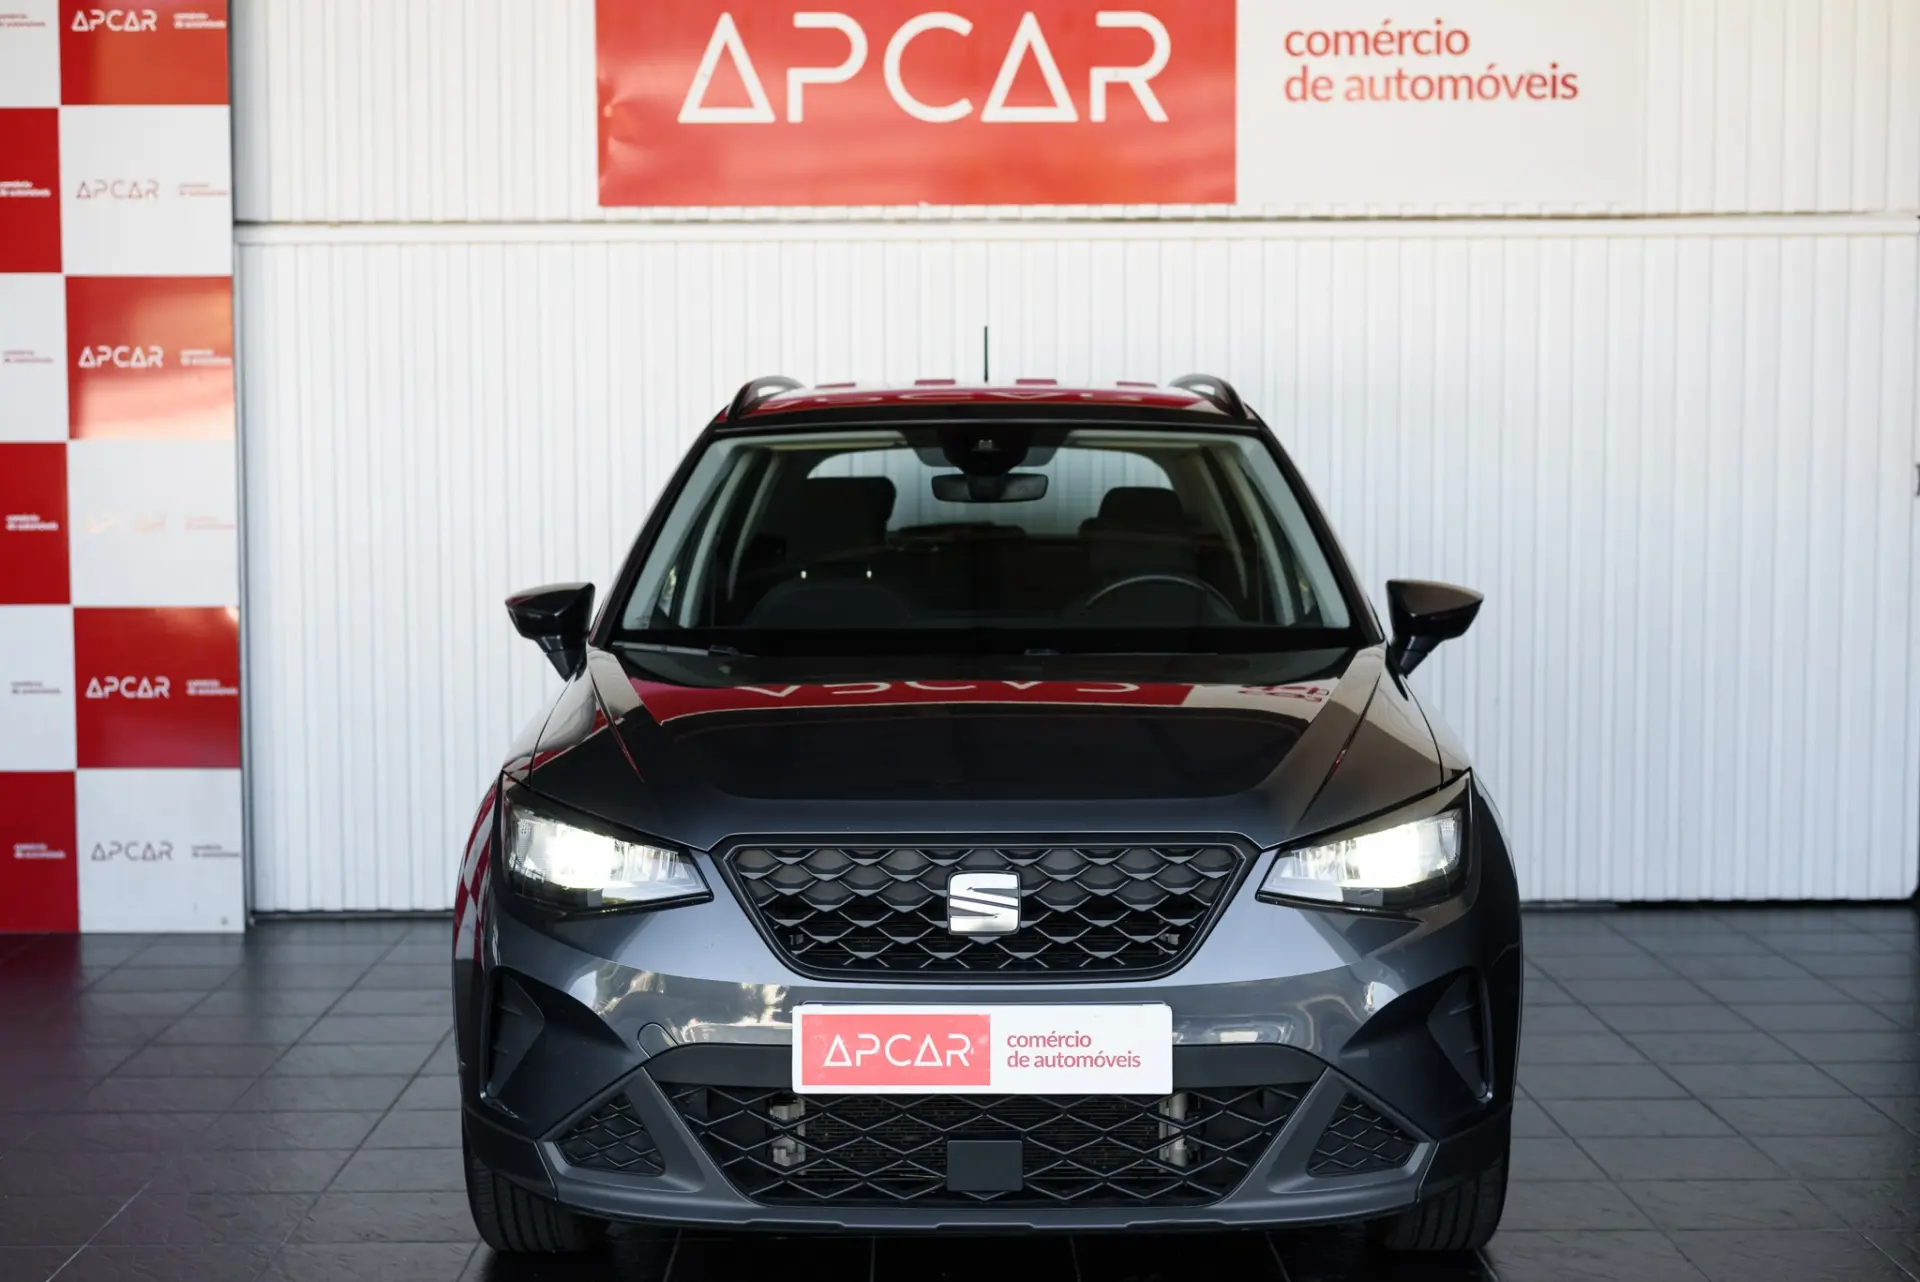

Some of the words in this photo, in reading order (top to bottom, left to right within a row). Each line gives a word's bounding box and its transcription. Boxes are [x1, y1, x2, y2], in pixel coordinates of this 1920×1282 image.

[71, 9, 158, 32] APCAR
[1284, 18, 1470, 57] comércio
[677, 11, 1172, 124] APCAR
[1284, 64, 1334, 102] de
[1344, 62, 1579, 102] automóveis
[76, 179, 160, 200] APCAR
[78, 345, 165, 368] APCAR
[85, 676, 171, 698] APCAR
[90, 841, 174, 861] APCAR
[823, 1033, 972, 1067] APCAR
[1006, 1030, 1092, 1048] comércio
[1006, 1050, 1030, 1068] de
[1033, 1050, 1142, 1068] automóveis
